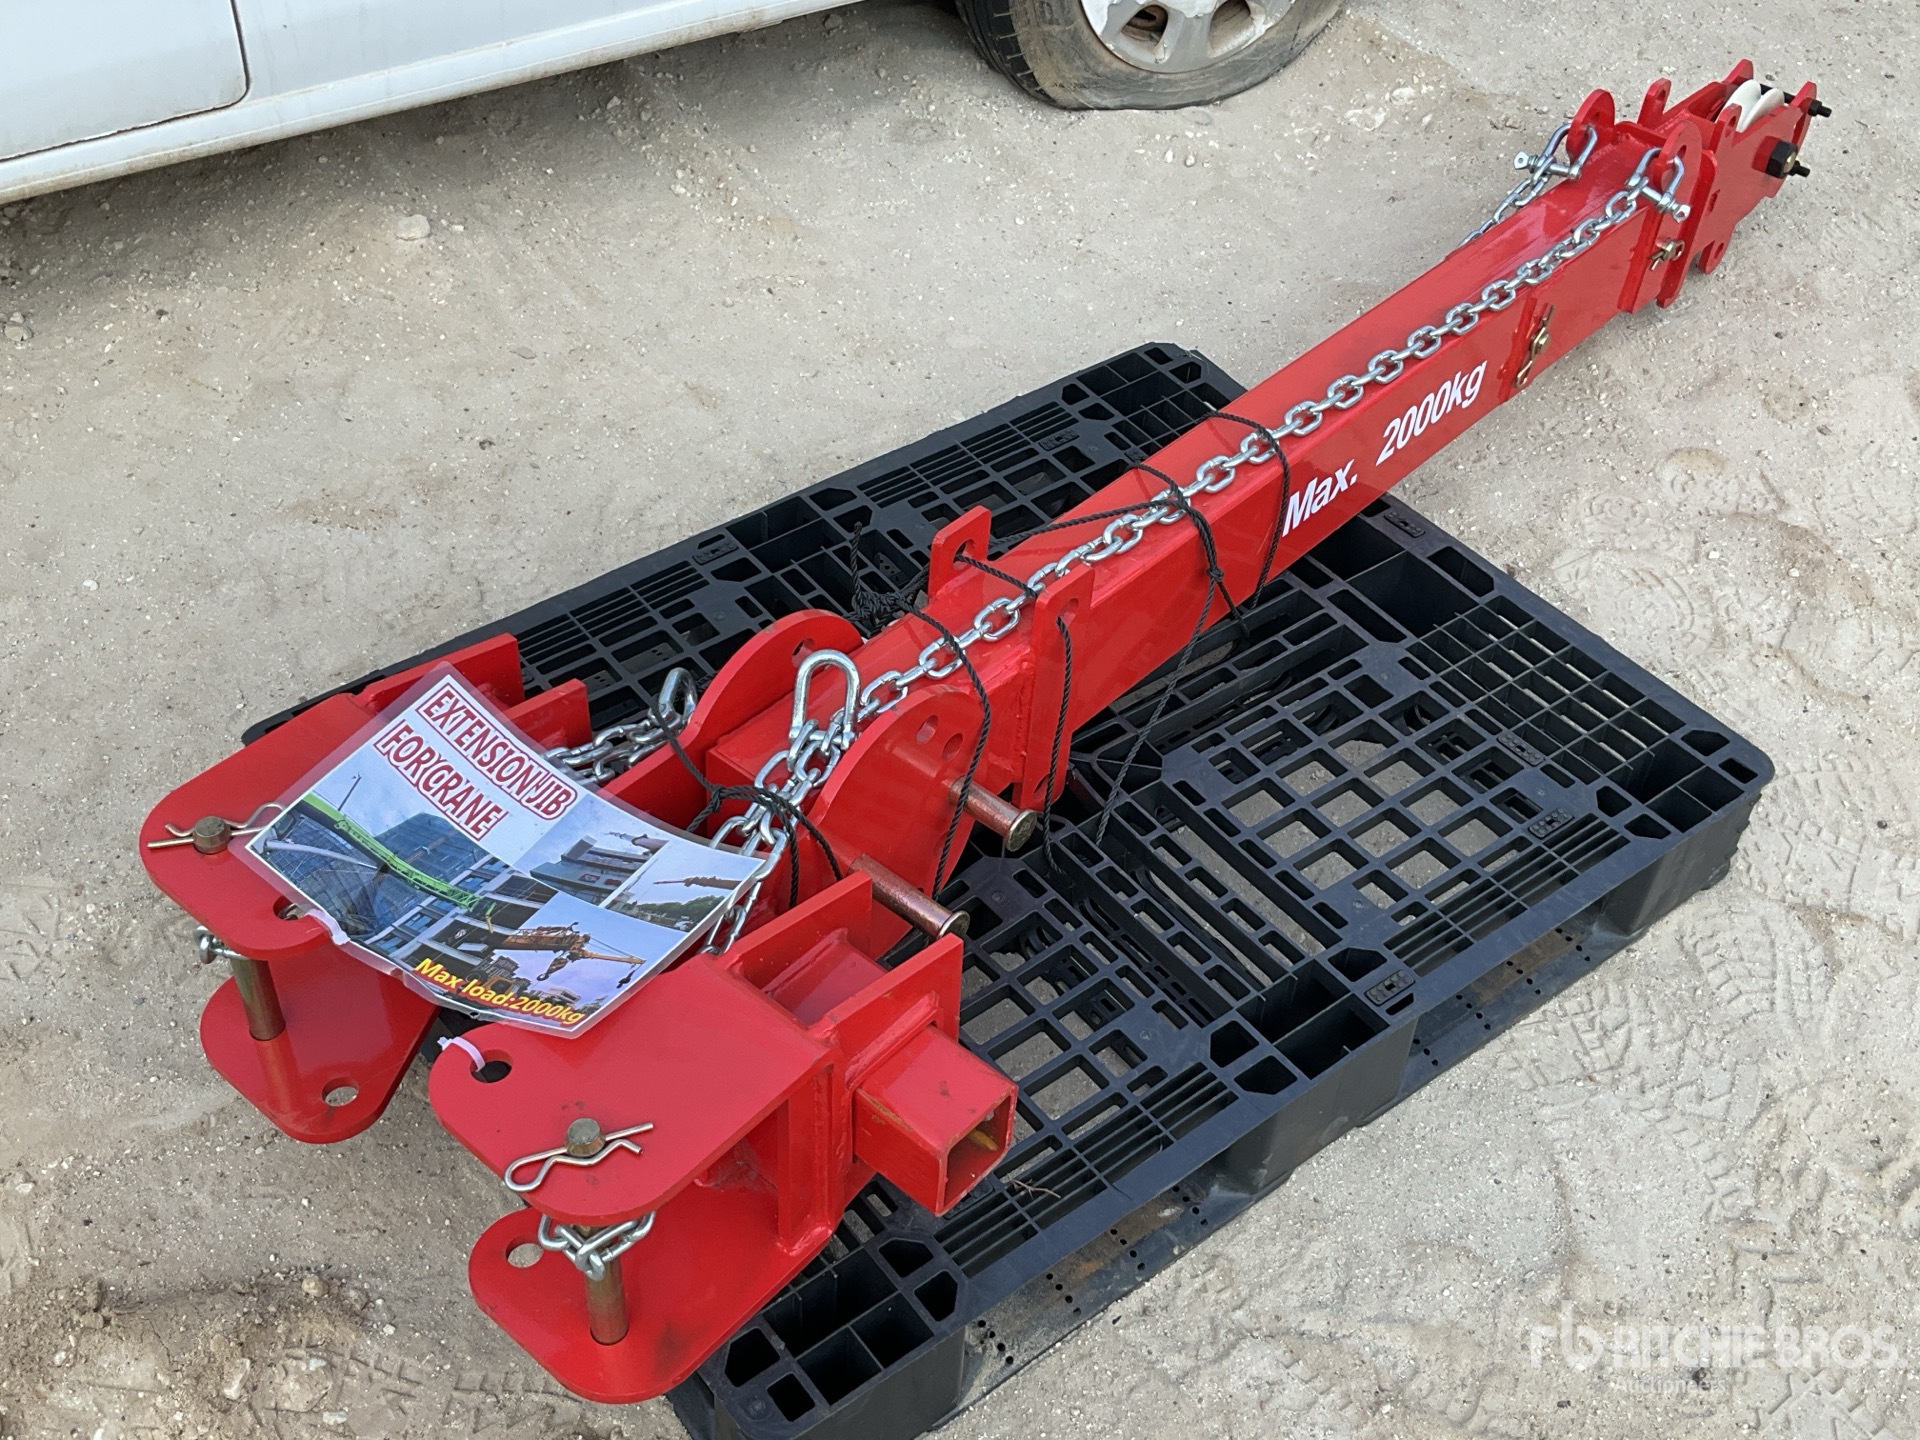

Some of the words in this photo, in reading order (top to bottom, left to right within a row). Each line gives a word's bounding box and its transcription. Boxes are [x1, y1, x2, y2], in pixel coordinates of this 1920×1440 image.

[1282, 458, 1358, 538] Max.
[1375, 359, 1488, 467] 2000kg
[381, 721, 440, 779] FOR
[421, 762, 504, 837] CRANE
[420, 687, 548, 798] EXTENSION
[524, 778, 573, 818] JIB
[414, 957, 463, 989] Max
[462, 978, 586, 1025] load:2000kg
